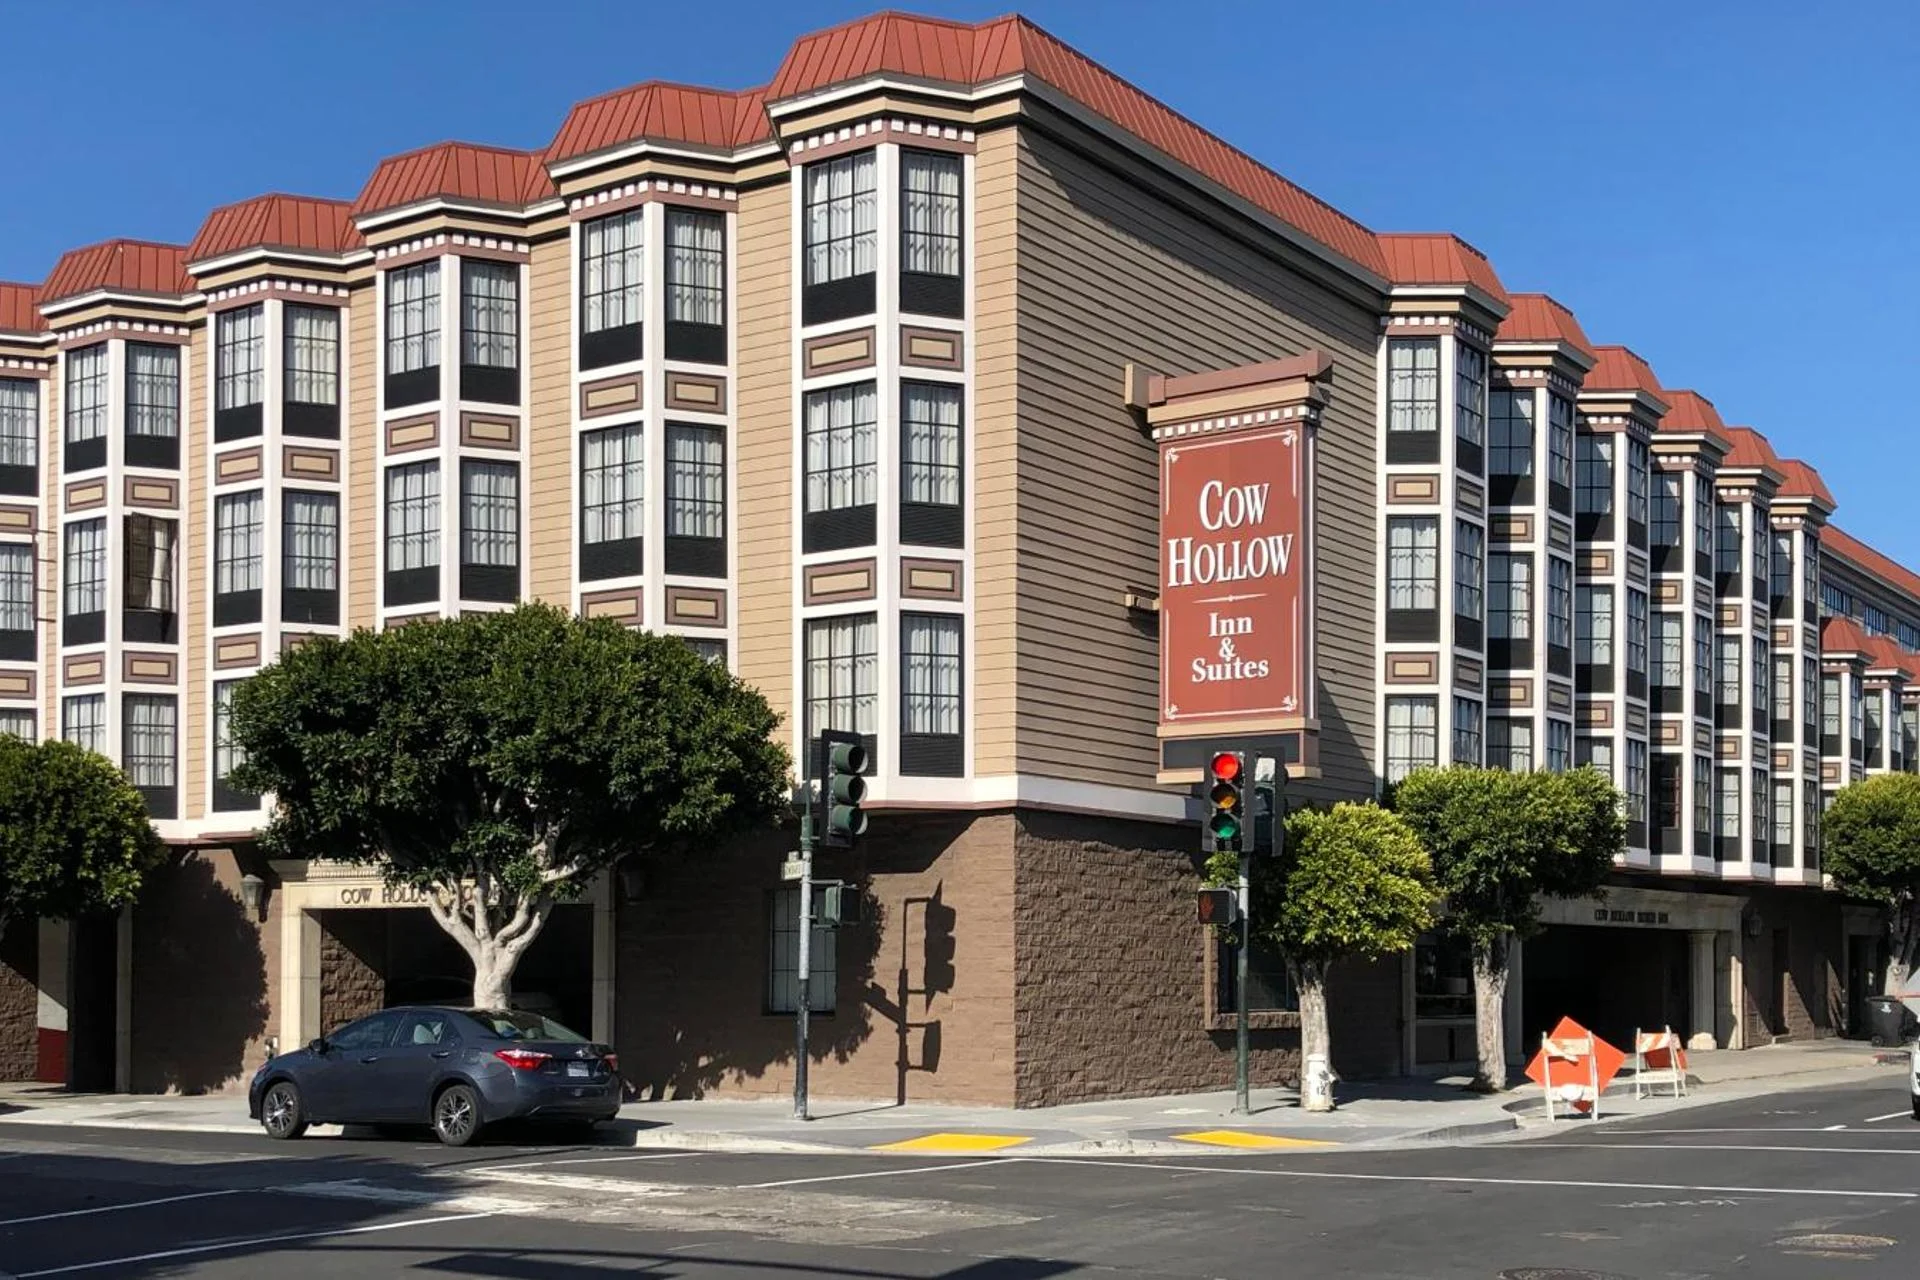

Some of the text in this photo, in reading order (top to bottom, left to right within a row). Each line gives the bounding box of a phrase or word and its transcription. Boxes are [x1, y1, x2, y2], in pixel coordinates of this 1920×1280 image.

[1199, 480, 1270, 531] COW
[1167, 533, 1294, 587] HOLLOW
[1208, 612, 1254, 637] Inn
[1219, 636, 1237, 658] &
[1191, 656, 1269, 683] Suites
[341, 887, 373, 904] COW
